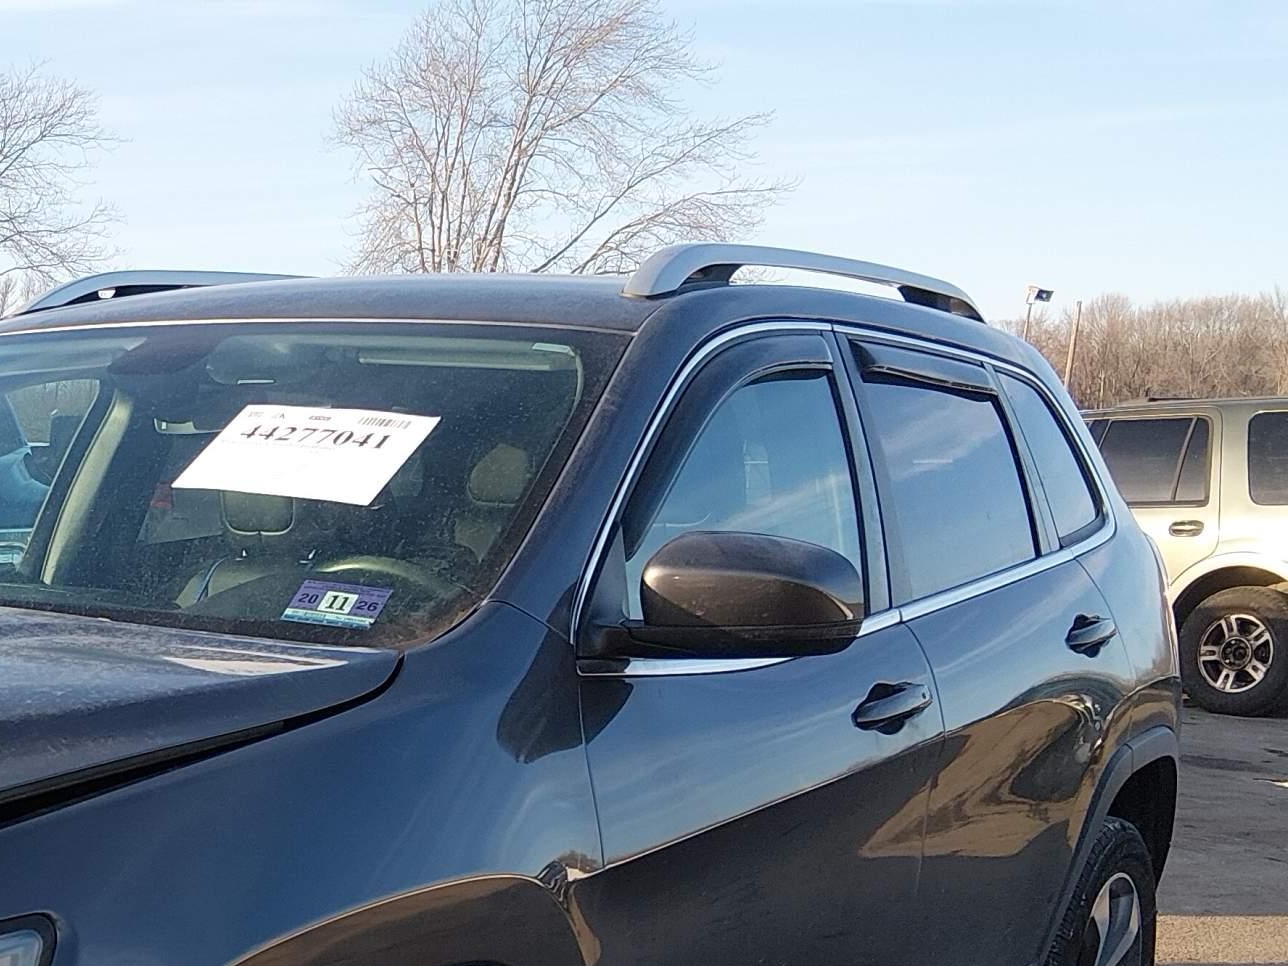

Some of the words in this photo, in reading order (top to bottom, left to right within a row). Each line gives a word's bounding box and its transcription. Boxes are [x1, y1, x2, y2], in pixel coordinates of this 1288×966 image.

[240, 425, 391, 449] 44277041
[298, 593, 319, 604] 20
[325, 594, 349, 611] 11
[356, 600, 379, 612] 26
